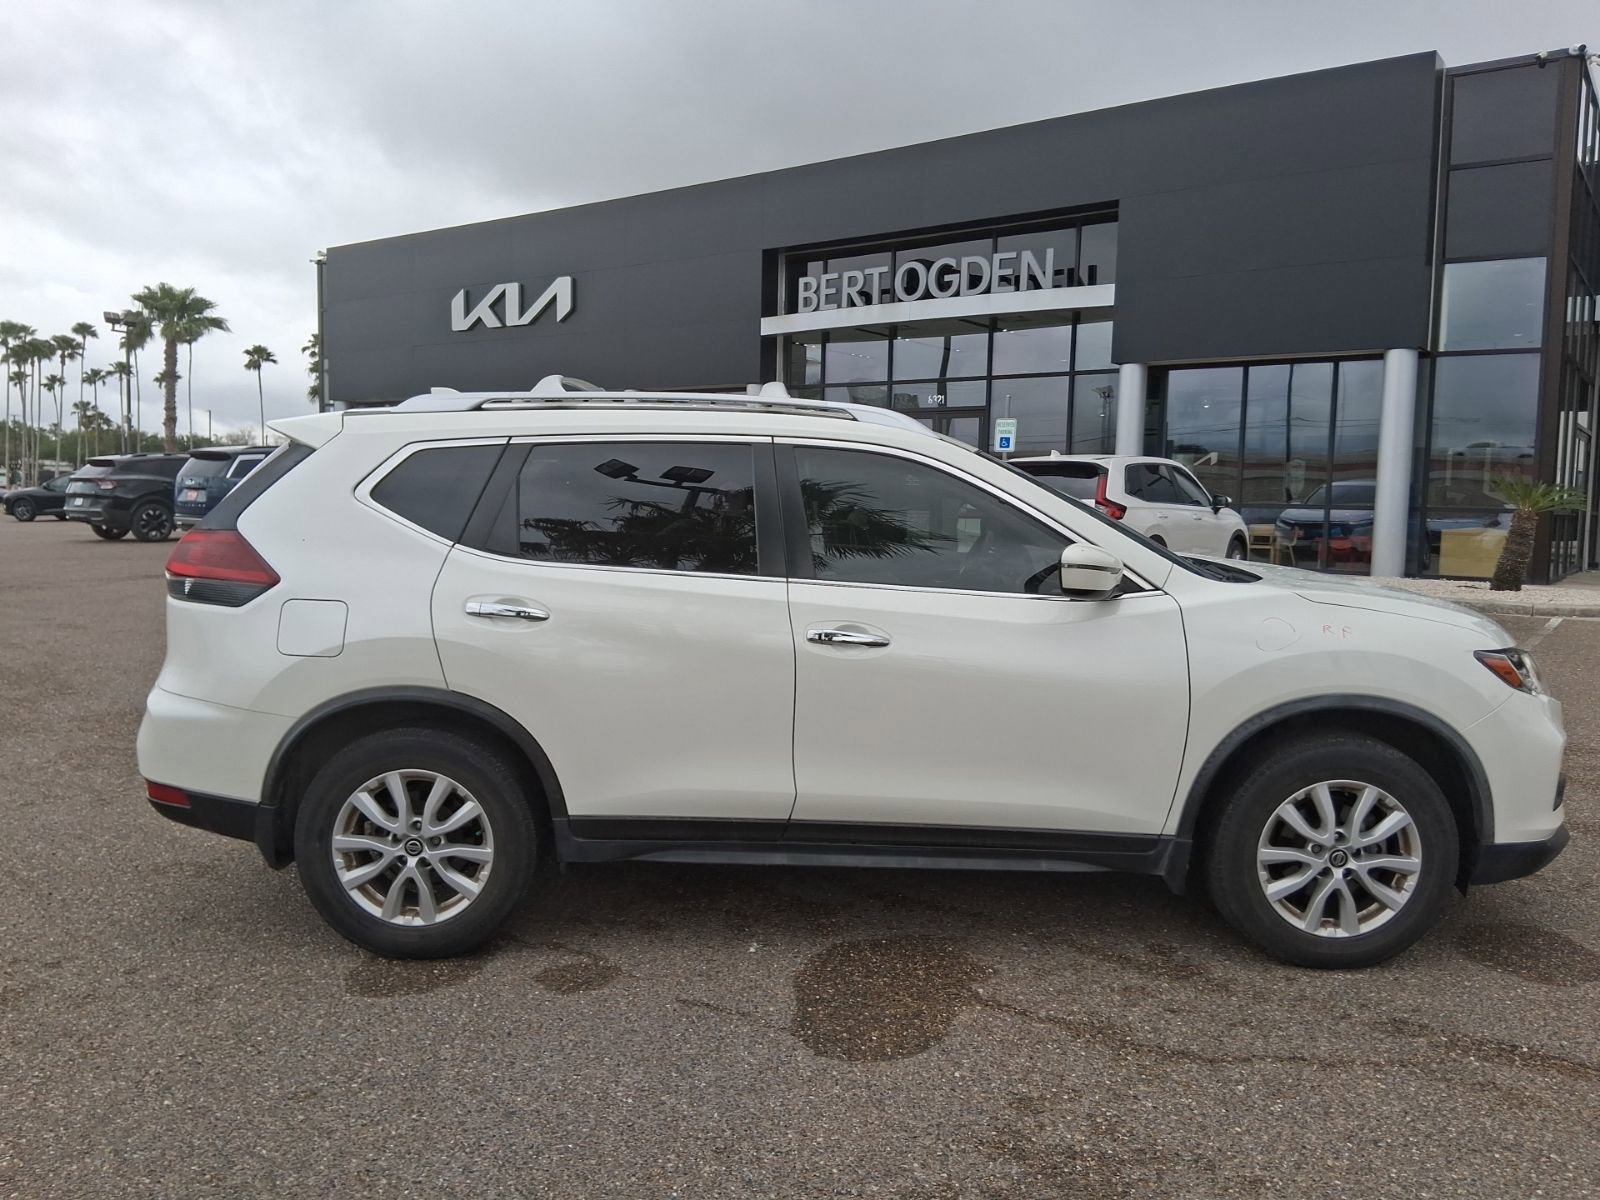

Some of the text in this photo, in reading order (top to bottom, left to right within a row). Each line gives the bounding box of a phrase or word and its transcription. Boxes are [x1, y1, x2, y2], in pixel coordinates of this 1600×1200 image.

[451, 275, 571, 332] KIA
[798, 248, 1055, 313] BERT OGDEN
